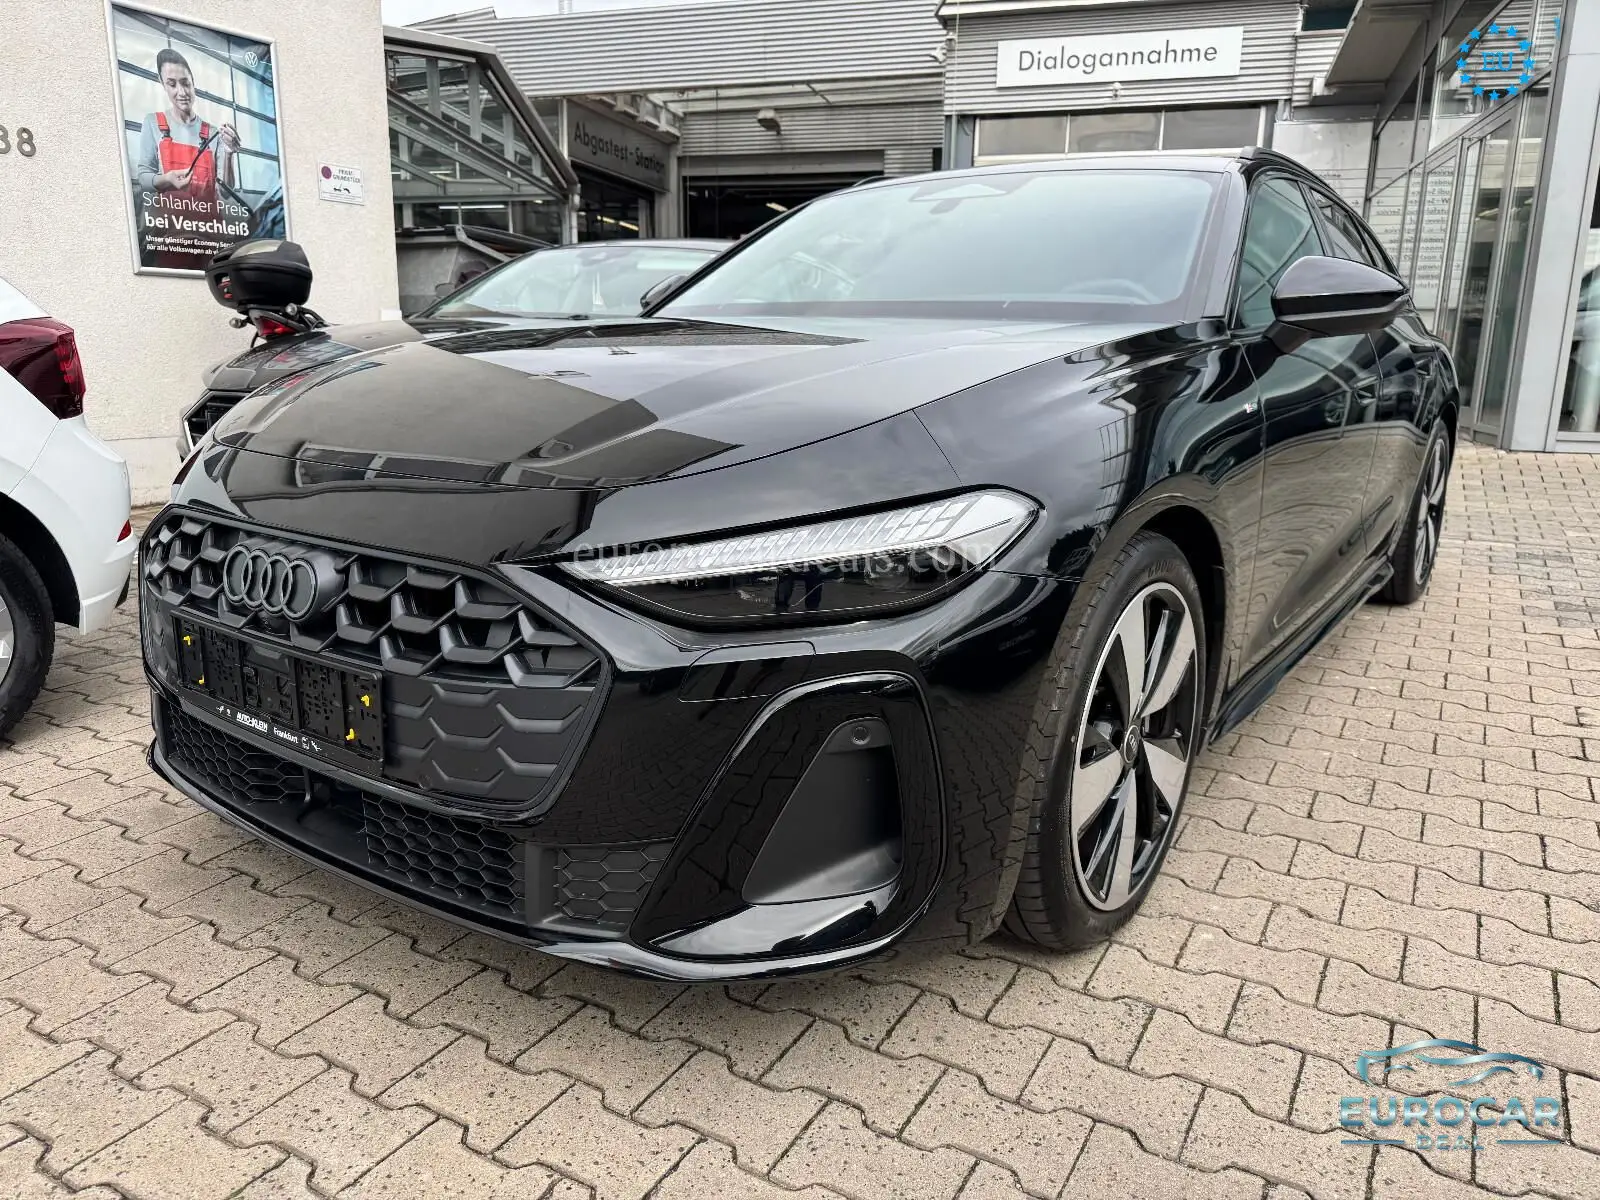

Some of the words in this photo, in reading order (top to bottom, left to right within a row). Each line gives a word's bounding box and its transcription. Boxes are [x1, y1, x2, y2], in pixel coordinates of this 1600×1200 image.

[1018, 39, 1218, 75] Dialogannahme
[142, 191, 213, 213] Schlanker
[216, 200, 249, 217] Preis
[144, 212, 169, 229] bei
[172, 214, 250, 237] Verschleiß
[145, 234, 165, 244] Unser
[165, 236, 194, 246] günstiger
[193, 238, 220, 249] Economy
[156, 244, 169, 252] alle
[168, 245, 205, 256] Volkswagen
[273, 726, 299, 744] Frankfurt
